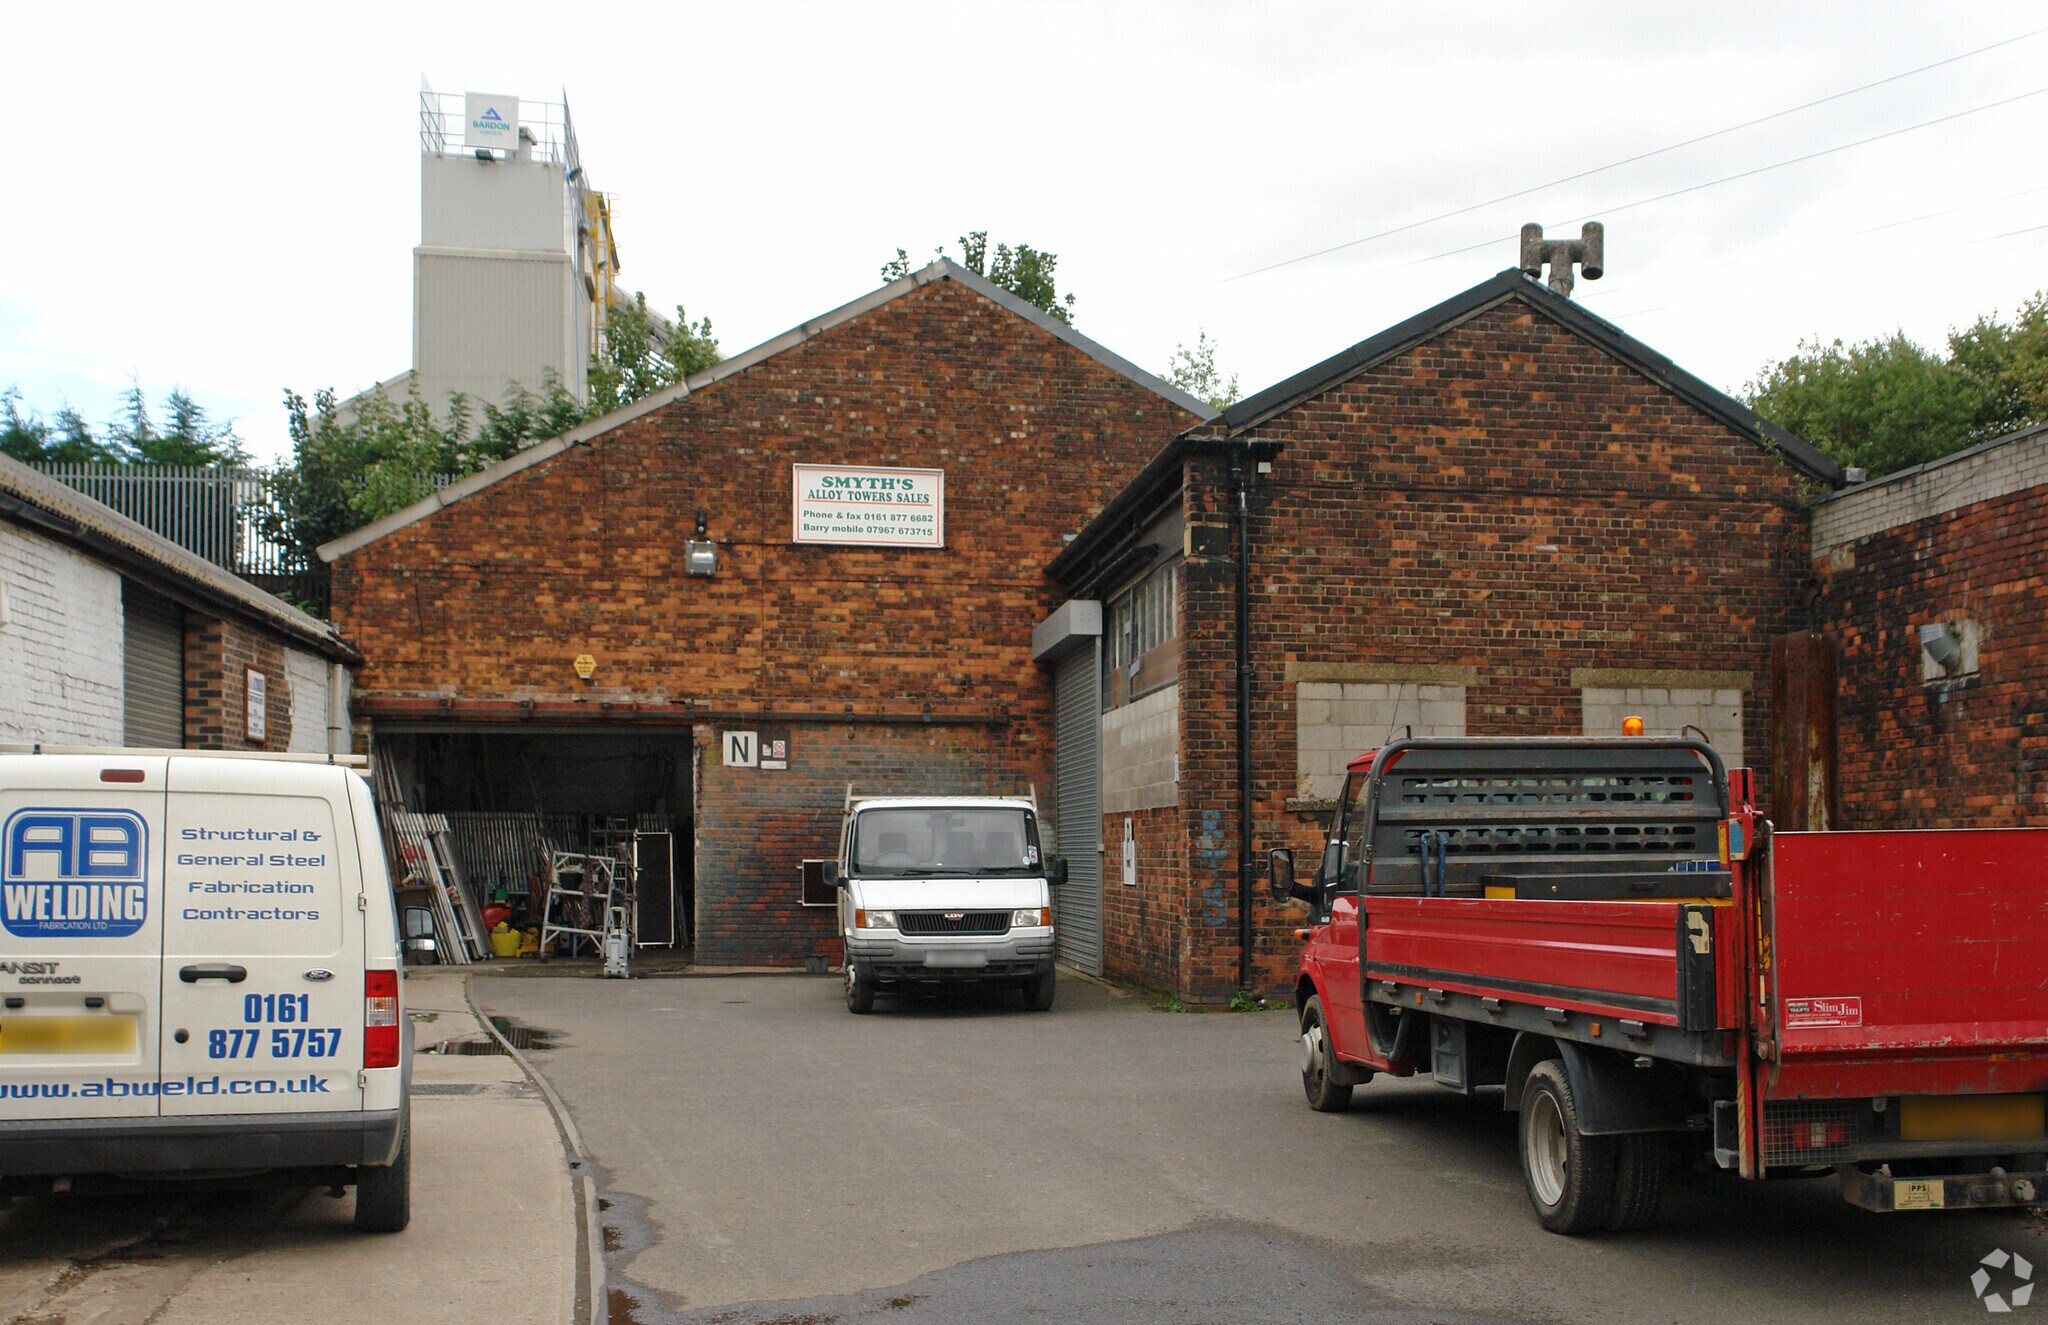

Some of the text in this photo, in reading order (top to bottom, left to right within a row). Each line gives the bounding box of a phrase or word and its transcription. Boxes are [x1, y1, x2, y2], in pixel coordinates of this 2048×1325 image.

[473, 121, 510, 130] BARDON
[821, 476, 914, 491] SMYTH'S
[808, 489, 930, 504] ALLOY TOWERS SALES
[803, 510, 933, 522] Phone & fax 0161 877 6682
[803, 523, 933, 536] Barry mobile 07967 673715
[731, 736, 748, 762] N
[181, 828, 321, 842] Structural &
[9, 815, 140, 878] AB
[177, 853, 325, 867] General Steel
[188, 880, 314, 894] Fabrication
[5, 885, 144, 920] WELDING
[183, 907, 319, 920] Contractors
[39, 921, 108, 931] FABRICATION LTD
[19, 975, 81, 984] connect
[244, 994, 309, 1023] 0161
[1813, 1000, 1838, 1012] Slim
[1838, 1003, 1858, 1015] Jim
[208, 1028, 342, 1059] 877 5757
